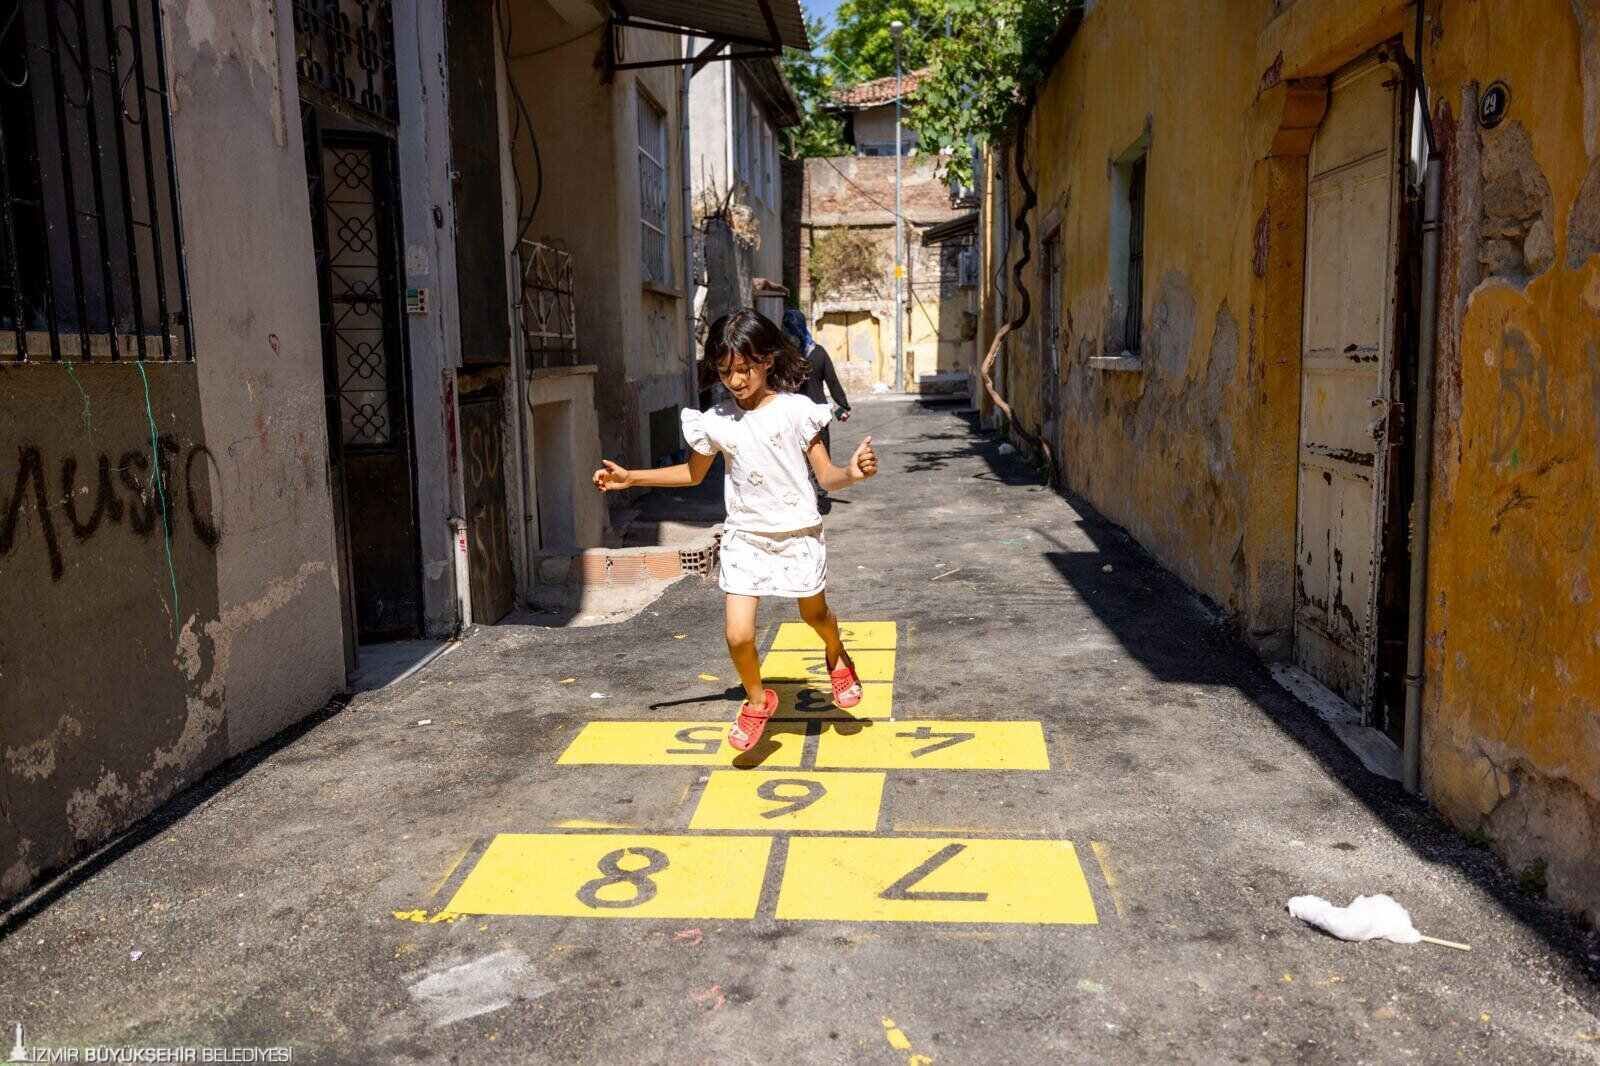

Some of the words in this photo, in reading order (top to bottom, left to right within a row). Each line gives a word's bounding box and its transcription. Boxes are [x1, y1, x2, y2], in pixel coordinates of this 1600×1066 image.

[665, 726, 725, 755] 5
[896, 726, 976, 758] 4
[575, 846, 671, 909] 8
[879, 843, 988, 901] 7
